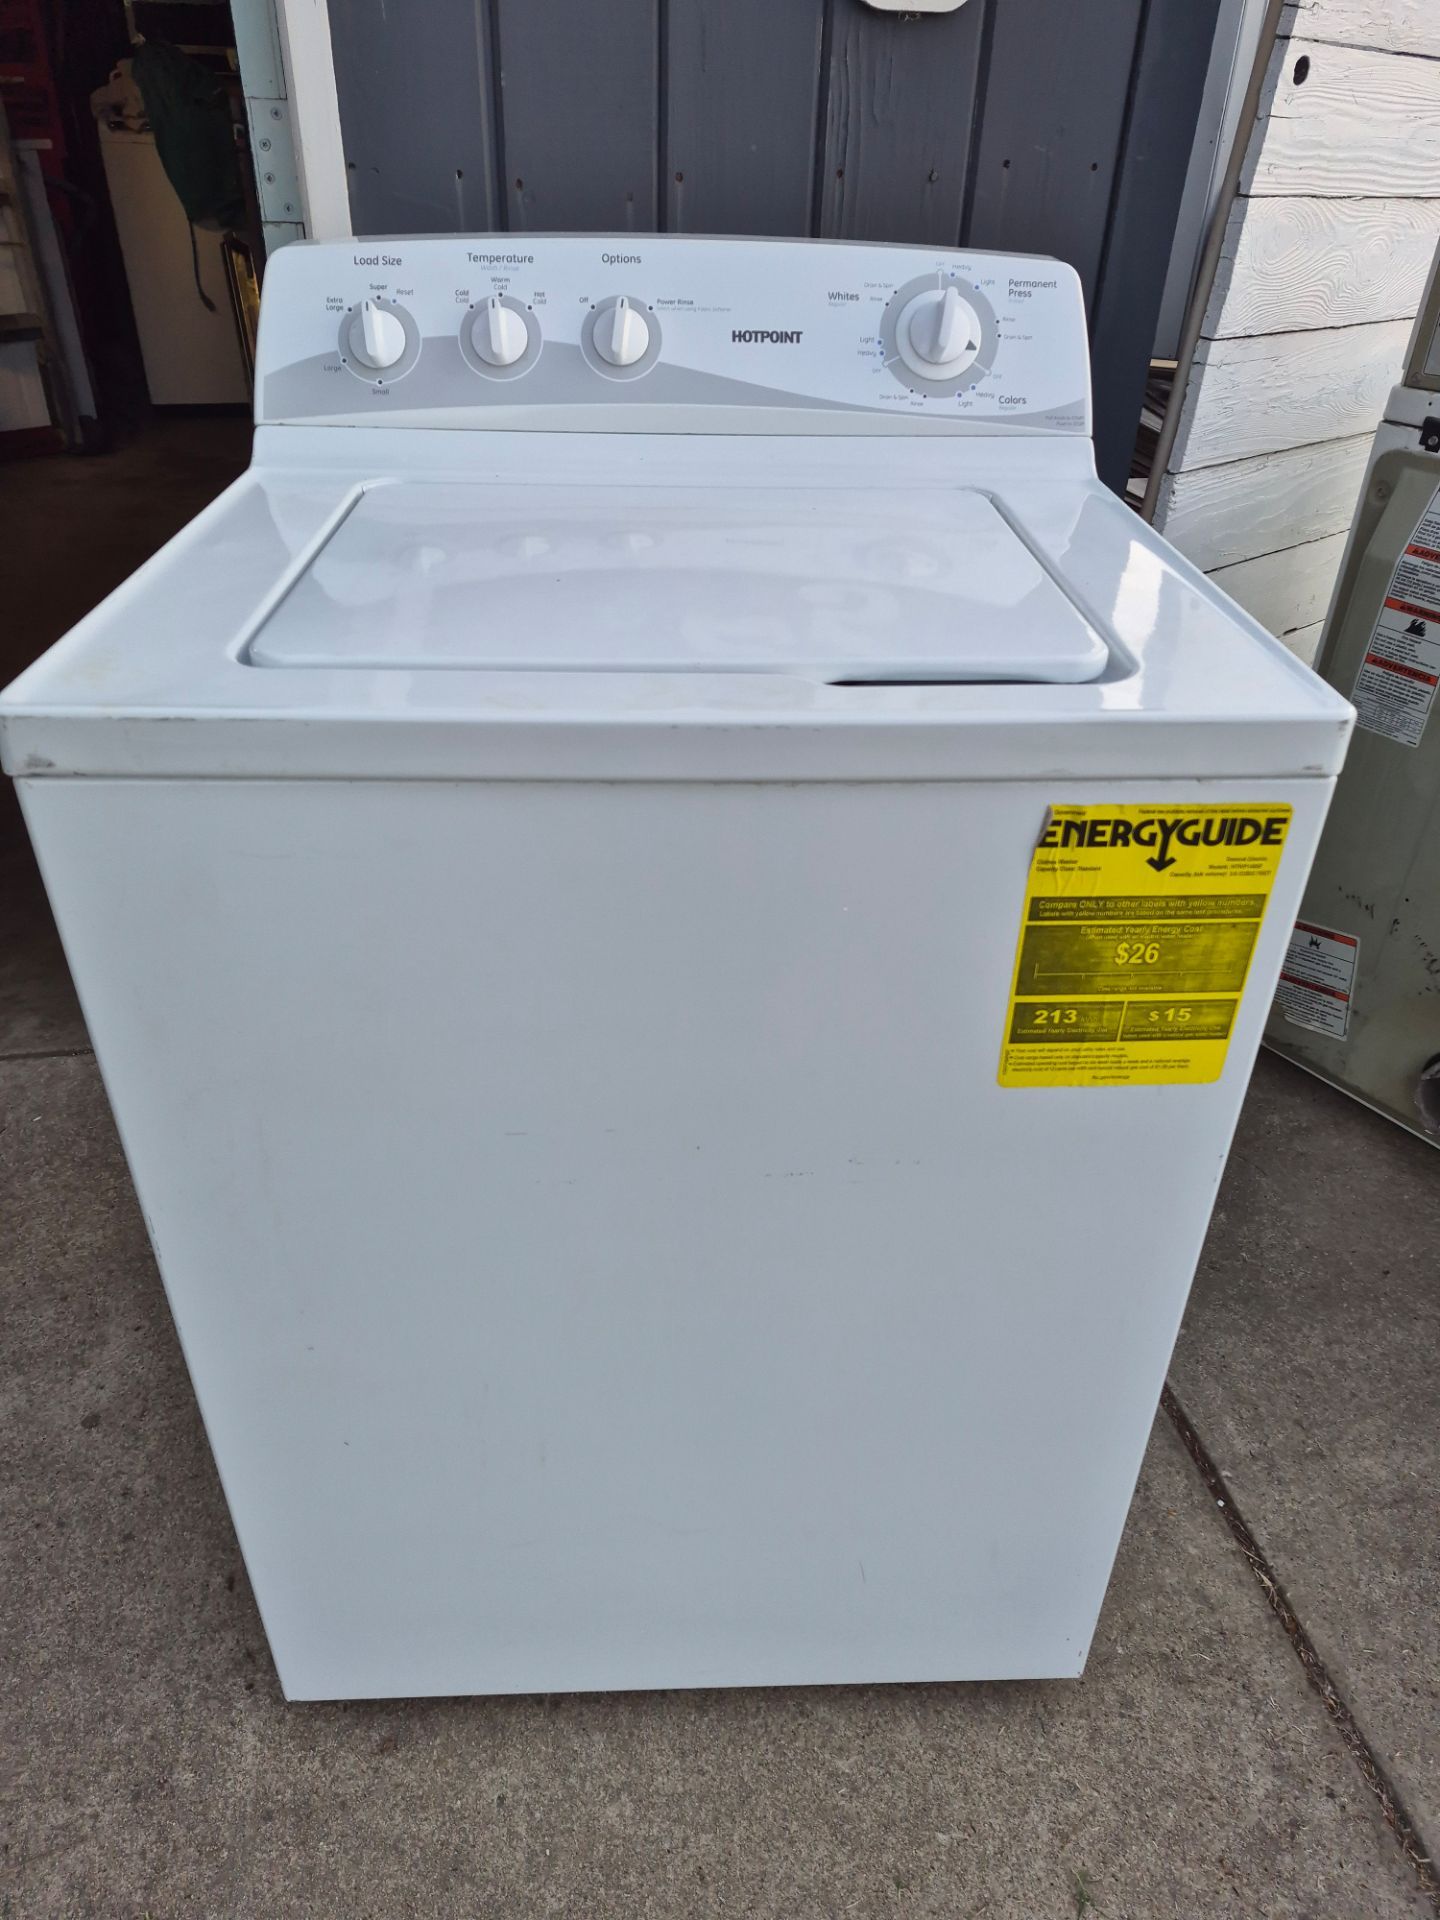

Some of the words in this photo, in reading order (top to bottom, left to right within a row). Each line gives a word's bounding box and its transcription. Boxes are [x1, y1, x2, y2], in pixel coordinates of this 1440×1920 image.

[353, 255, 379, 266] Load
[381, 255, 403, 266] Size
[467, 252, 535, 265] Temperature
[601, 253, 642, 266] Options
[490, 276, 511, 284] Warm
[980, 278, 996, 287] Light
[1008, 279, 1058, 289] Permanent
[369, 282, 388, 292] Super
[493, 283, 508, 291] Cold
[454, 289, 470, 297] Cold
[828, 291, 860, 302] Whites
[1008, 288, 1033, 299] Press
[326, 296, 343, 304] Extra
[657, 298, 676, 306] Power
[325, 303, 344, 313] Large
[731, 330, 804, 345] HOTPOINT
[859, 336, 875, 345] Light
[323, 364, 342, 374] Large
[372, 387, 390, 396] Small
[958, 399, 974, 408] Light
[998, 394, 1028, 406] Colors
[1038, 817, 1289, 850] ENERGYGUIDE
[1038, 900, 1077, 910] Compare
[1079, 899, 1104, 909] ONLY
[1105, 899, 1115, 909] to
[1116, 899, 1140, 908] other
[1141, 898, 1166, 908] labels
[1168, 898, 1187, 908] with
[1187, 898, 1216, 910] yellow
[1081, 925, 1123, 935] Estimated
[1124, 925, 1151, 936] Yearly
[1151, 925, 1182, 936] Energy
[1183, 924, 1205, 934] Cost
[1114, 941, 1160, 967] $26
[1033, 1008, 1078, 1025] 213
[1164, 1006, 1192, 1023] 15
